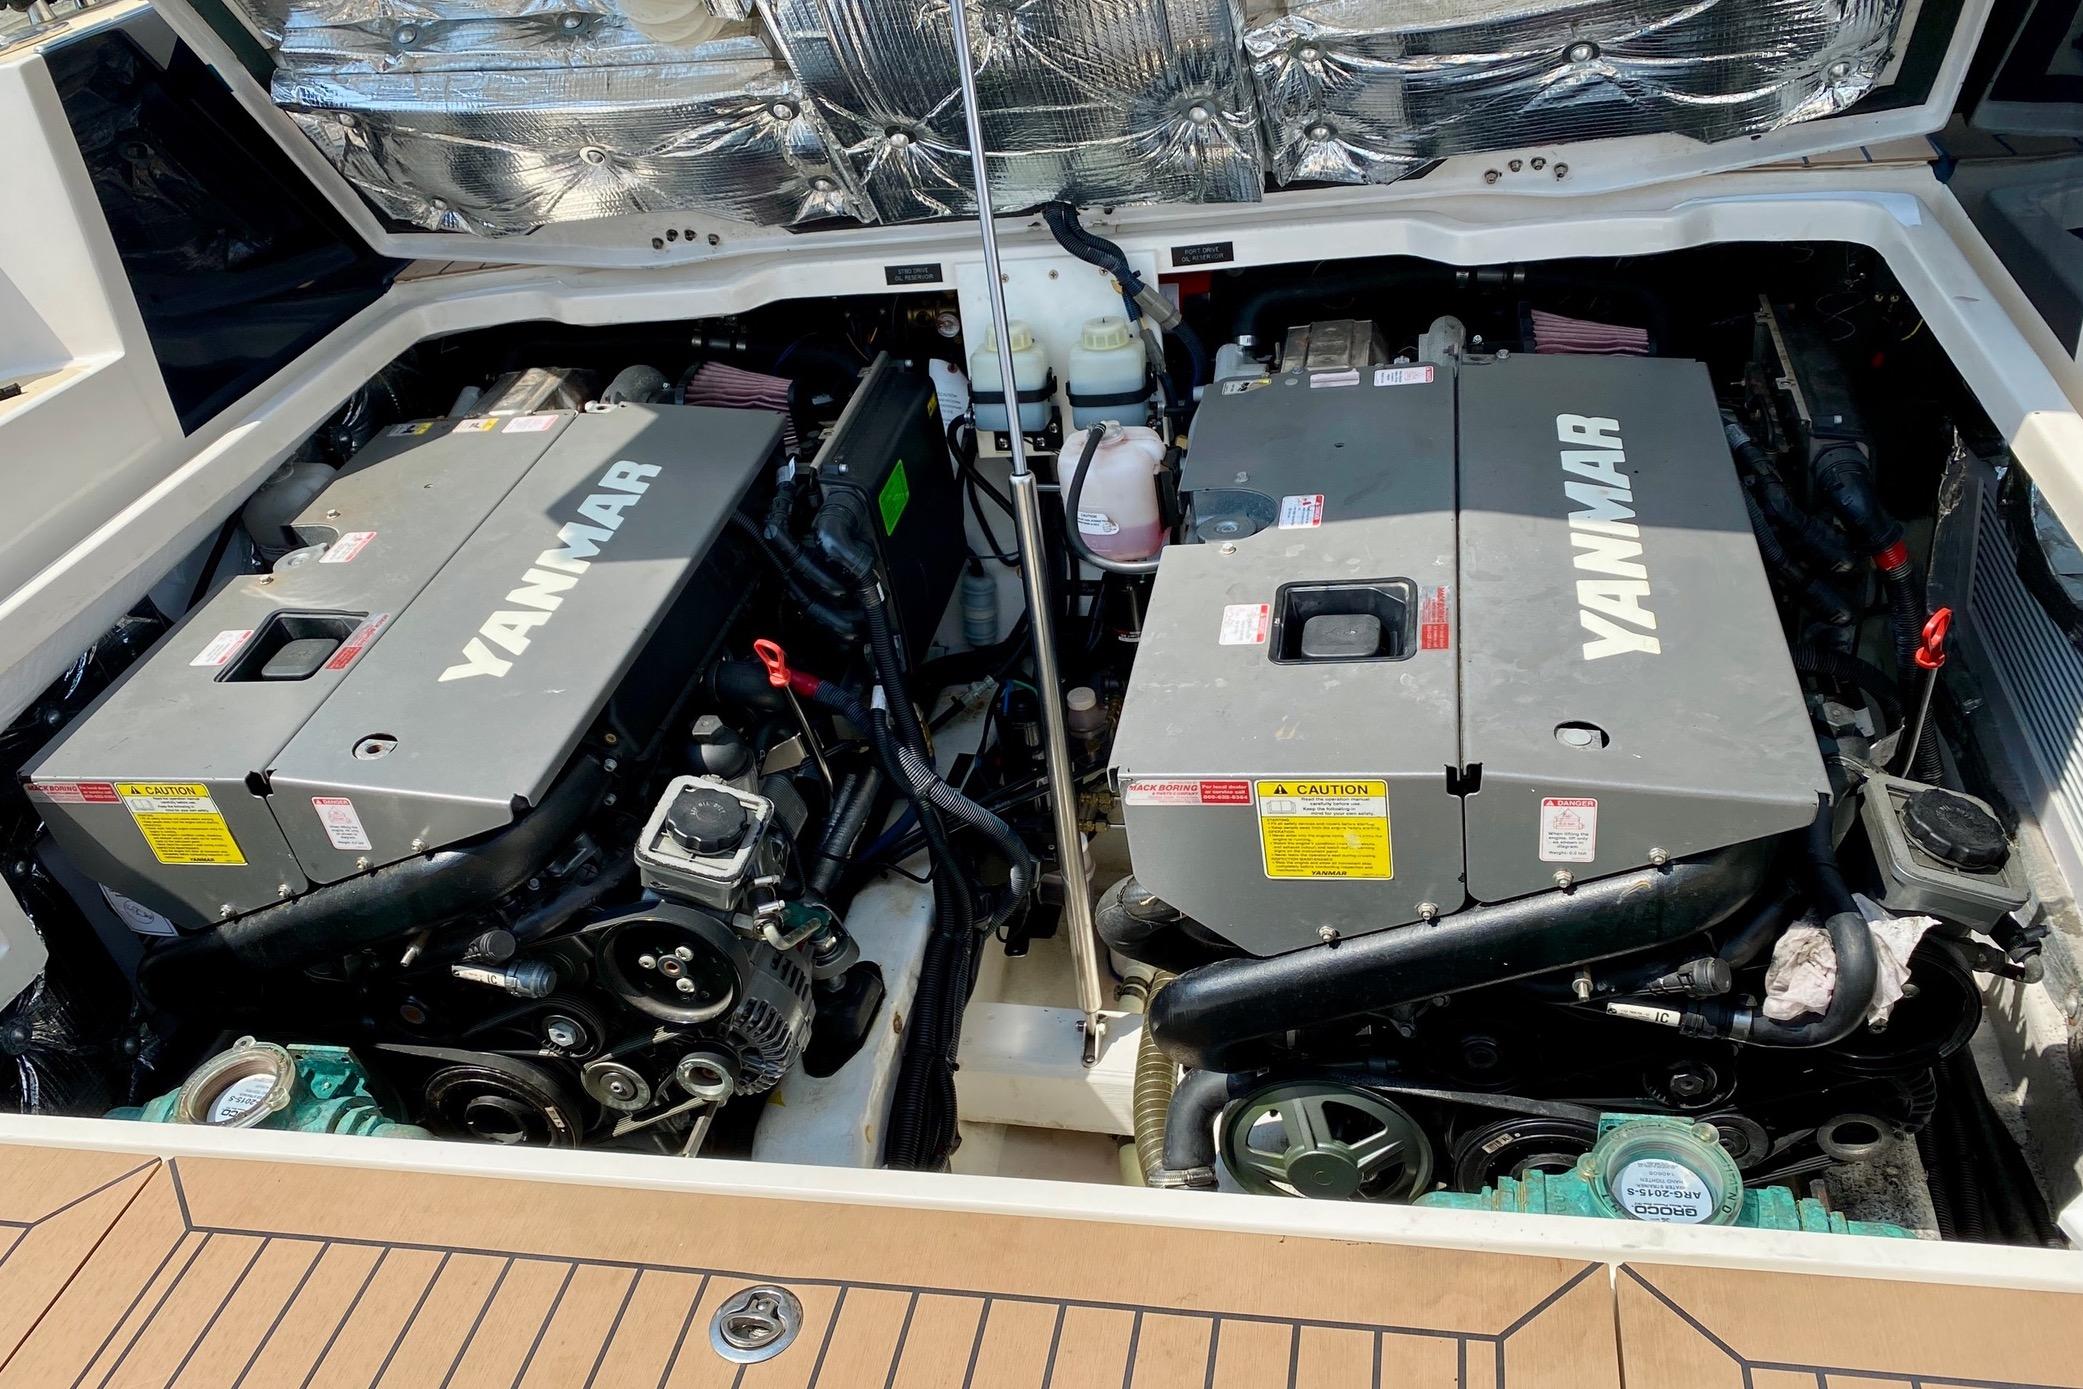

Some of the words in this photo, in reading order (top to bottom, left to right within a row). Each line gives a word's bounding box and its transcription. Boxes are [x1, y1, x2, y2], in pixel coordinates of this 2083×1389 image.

[1202, 246, 1220, 254] DRIVE
[1556, 413, 1661, 661] YANMAR
[438, 460, 662, 682] YANMAR
[145, 786, 196, 795] CAUTION
[1297, 784, 1369, 795] CAUTION
[1655, 1011, 1670, 1024] IC
[1626, 1188, 1702, 1199] ARG-2015-S
[1634, 1205, 1698, 1217] GROCO
